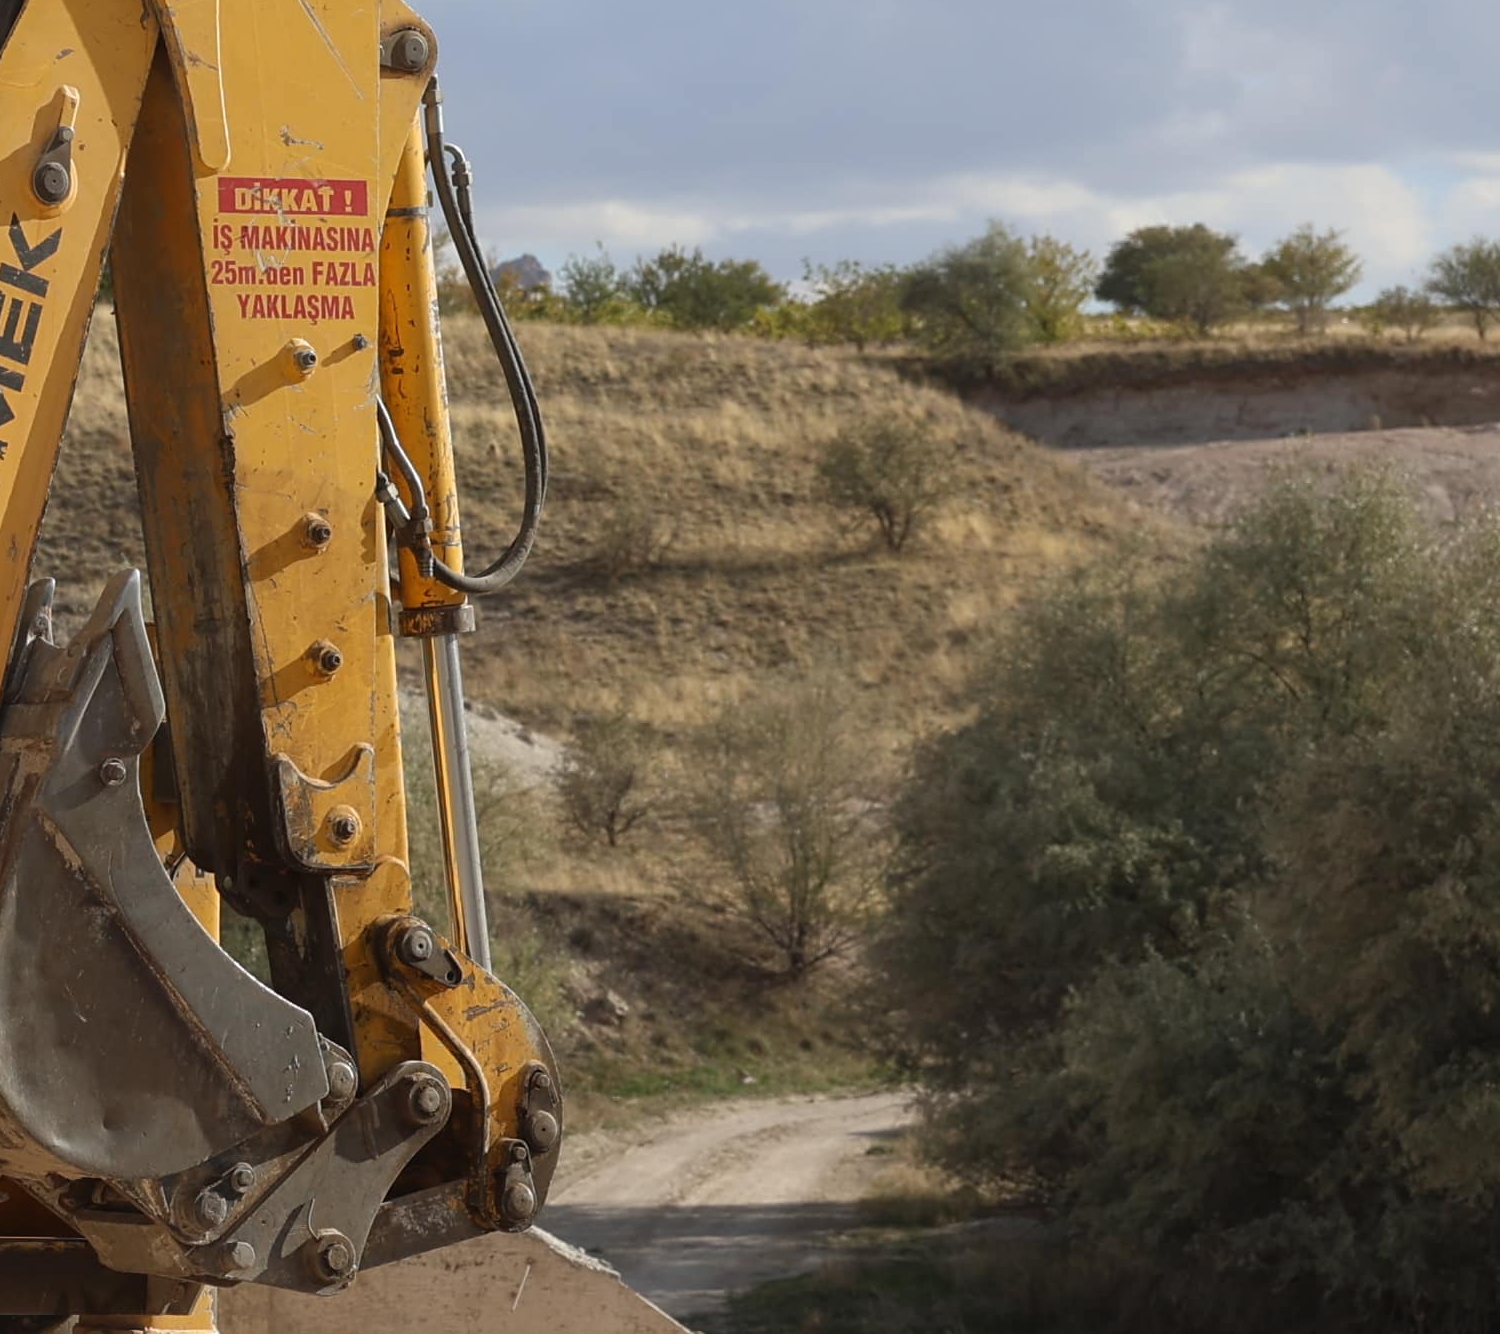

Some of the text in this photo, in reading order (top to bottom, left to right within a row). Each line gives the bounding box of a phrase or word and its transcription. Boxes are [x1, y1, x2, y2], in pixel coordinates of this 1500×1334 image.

[234, 181, 353, 213] DİKKAT !
[212, 218, 375, 256] İŞ MAKİNASINA
[311, 261, 376, 287] FAZLA
[236, 293, 356, 326] YAKLAŞMA
